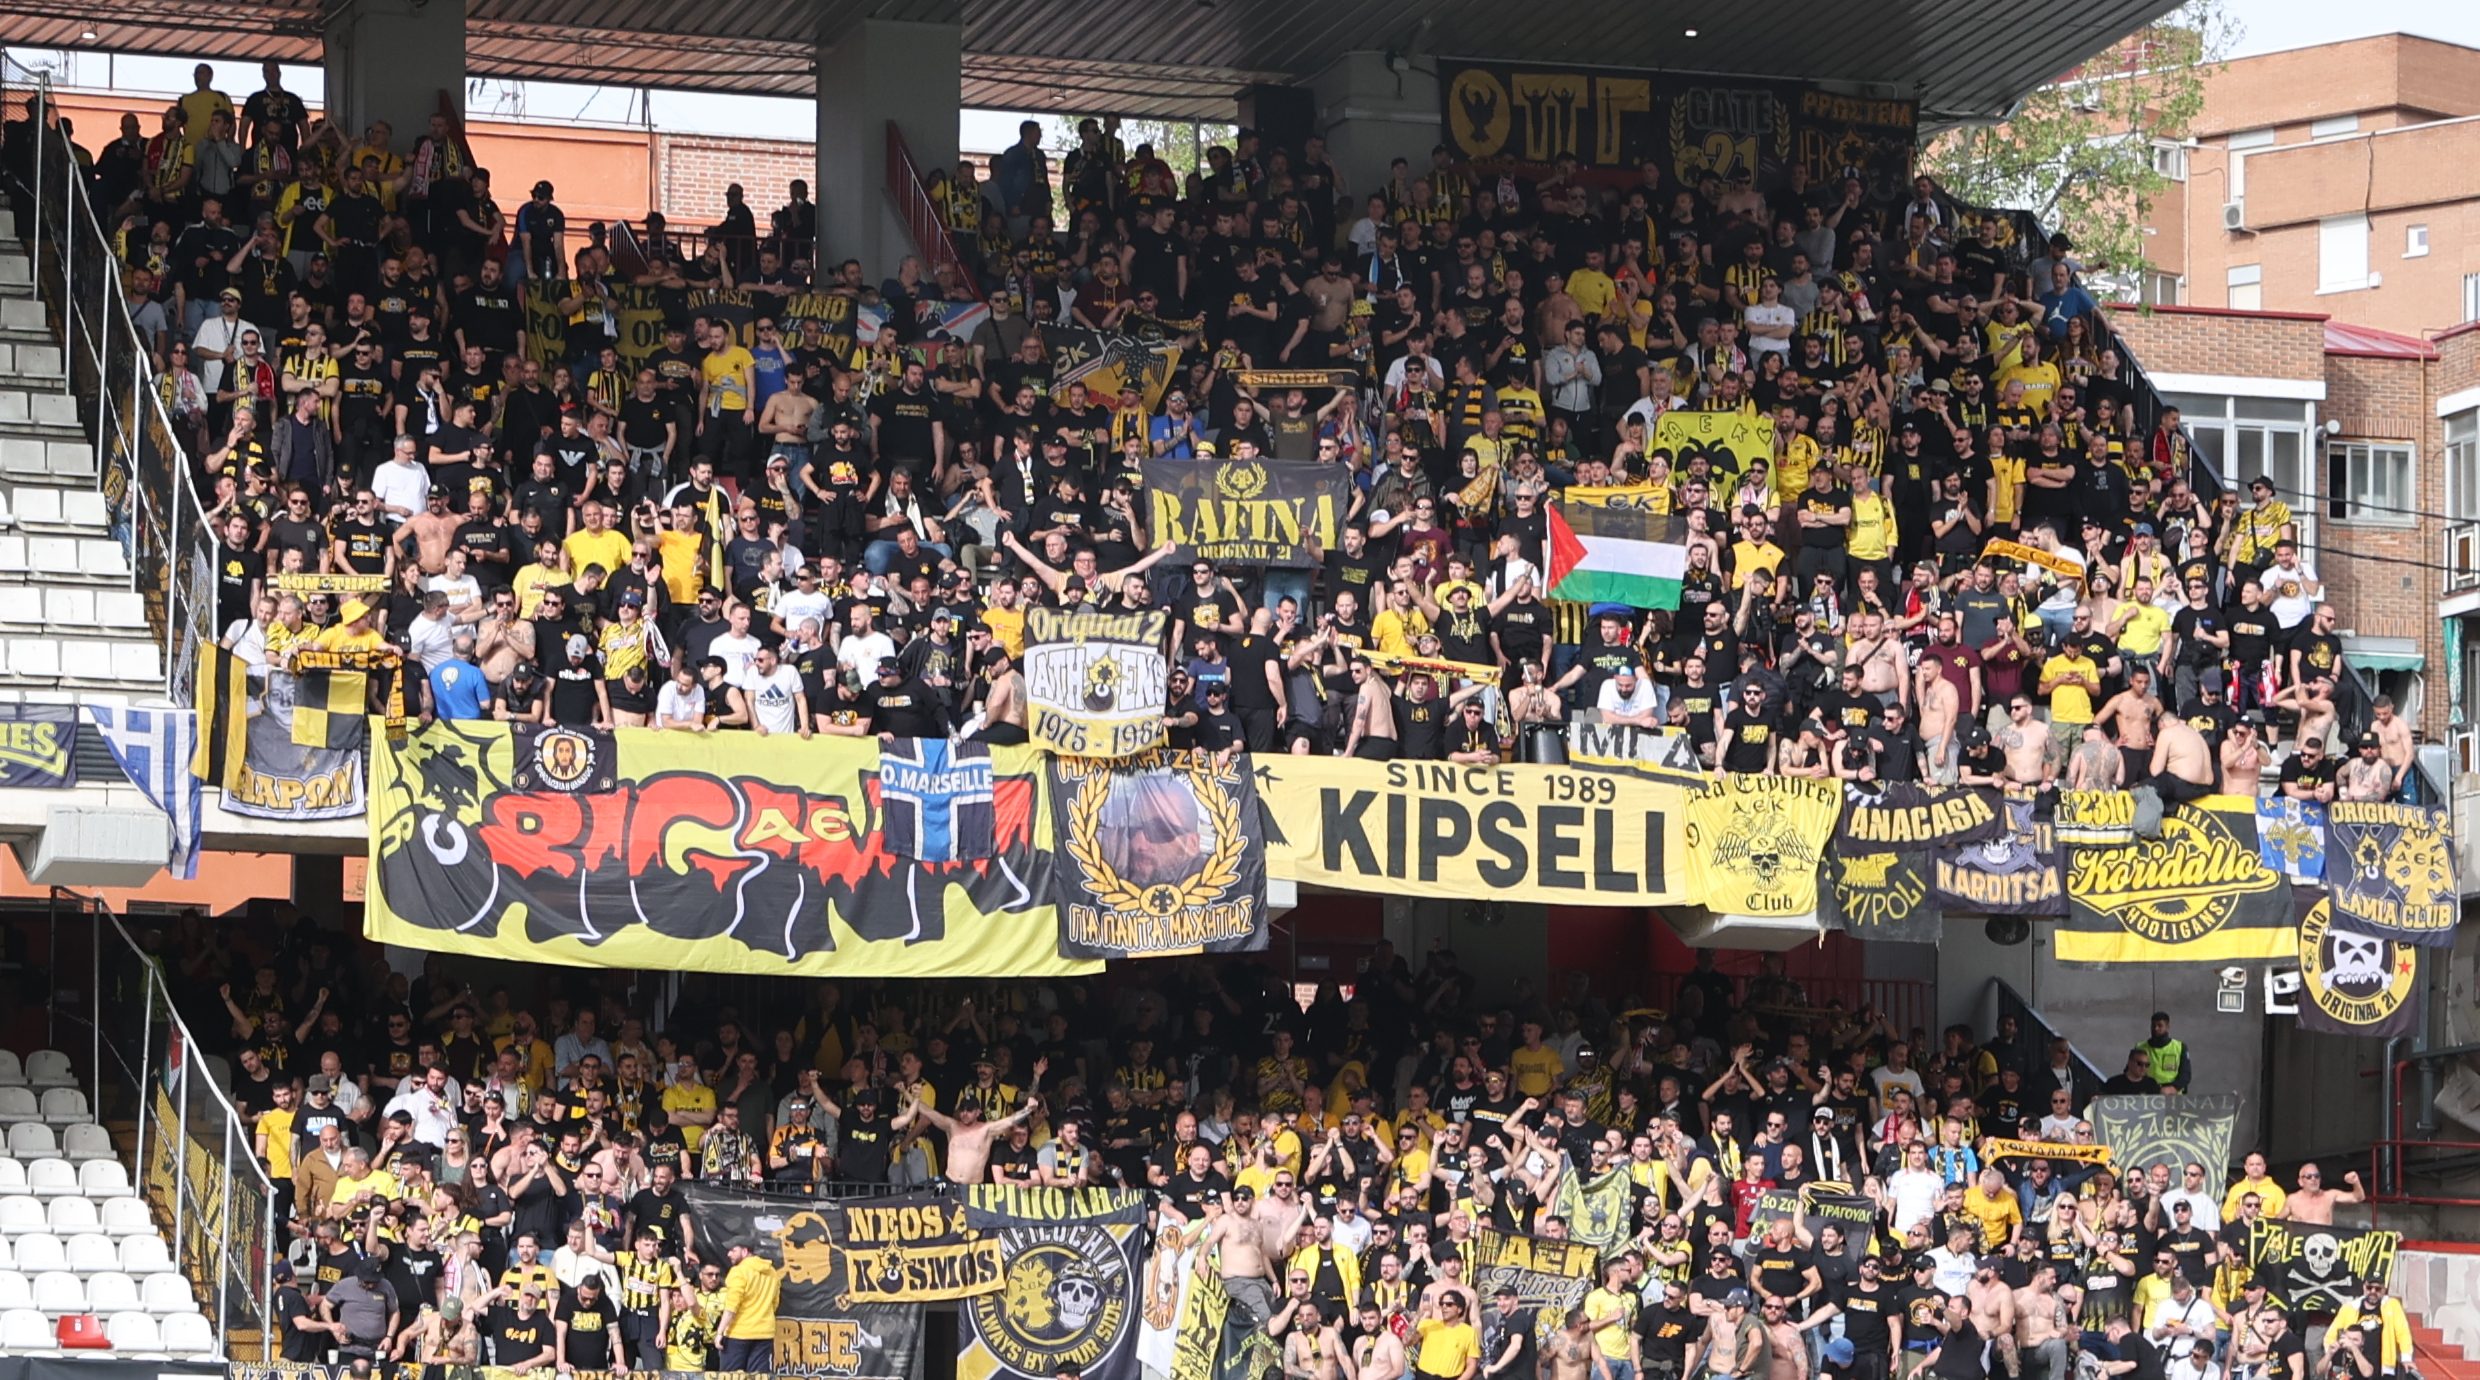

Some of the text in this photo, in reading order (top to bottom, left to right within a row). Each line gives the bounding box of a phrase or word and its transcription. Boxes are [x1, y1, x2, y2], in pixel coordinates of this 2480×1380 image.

[1687, 87, 1774, 133] GATE
[1151, 489, 1337, 551] RAFINA
[1197, 545, 1292, 561] ORIGINAL 21
[1030, 606, 1166, 648] Original 2
[1035, 710, 1087, 752] 1975
[880, 764, 993, 794] O.MARSEILLE
[1386, 762, 1617, 804] SINCE 1989
[1848, 793, 1995, 842] ANACASA
[2330, 802, 2453, 835] ORIGINAL 2
[1319, 787, 1667, 894] KIPSELI
[1936, 857, 2060, 905] KARDITSA
[2067, 838, 2263, 897] Koridallo
[1070, 897, 1254, 948] ΓΙΑ ΠΑΝΤΑ ΜΑΧΗΤΗΣ
[1746, 893, 1793, 911] Club
[2126, 899, 2226, 941] HOOLIGANS
[2335, 887, 2454, 930] LAMIA CLUB
[2320, 990, 2399, 1021] ORIGINAL 21
[2103, 1095, 2236, 1111] ORIGINAL
[846, 1204, 944, 1242] NEOS
[999, 1225, 1125, 1281] MFILOCHIA
[1095, 1297, 1124, 1342] SIDE
[773, 1319, 861, 1375] REE
